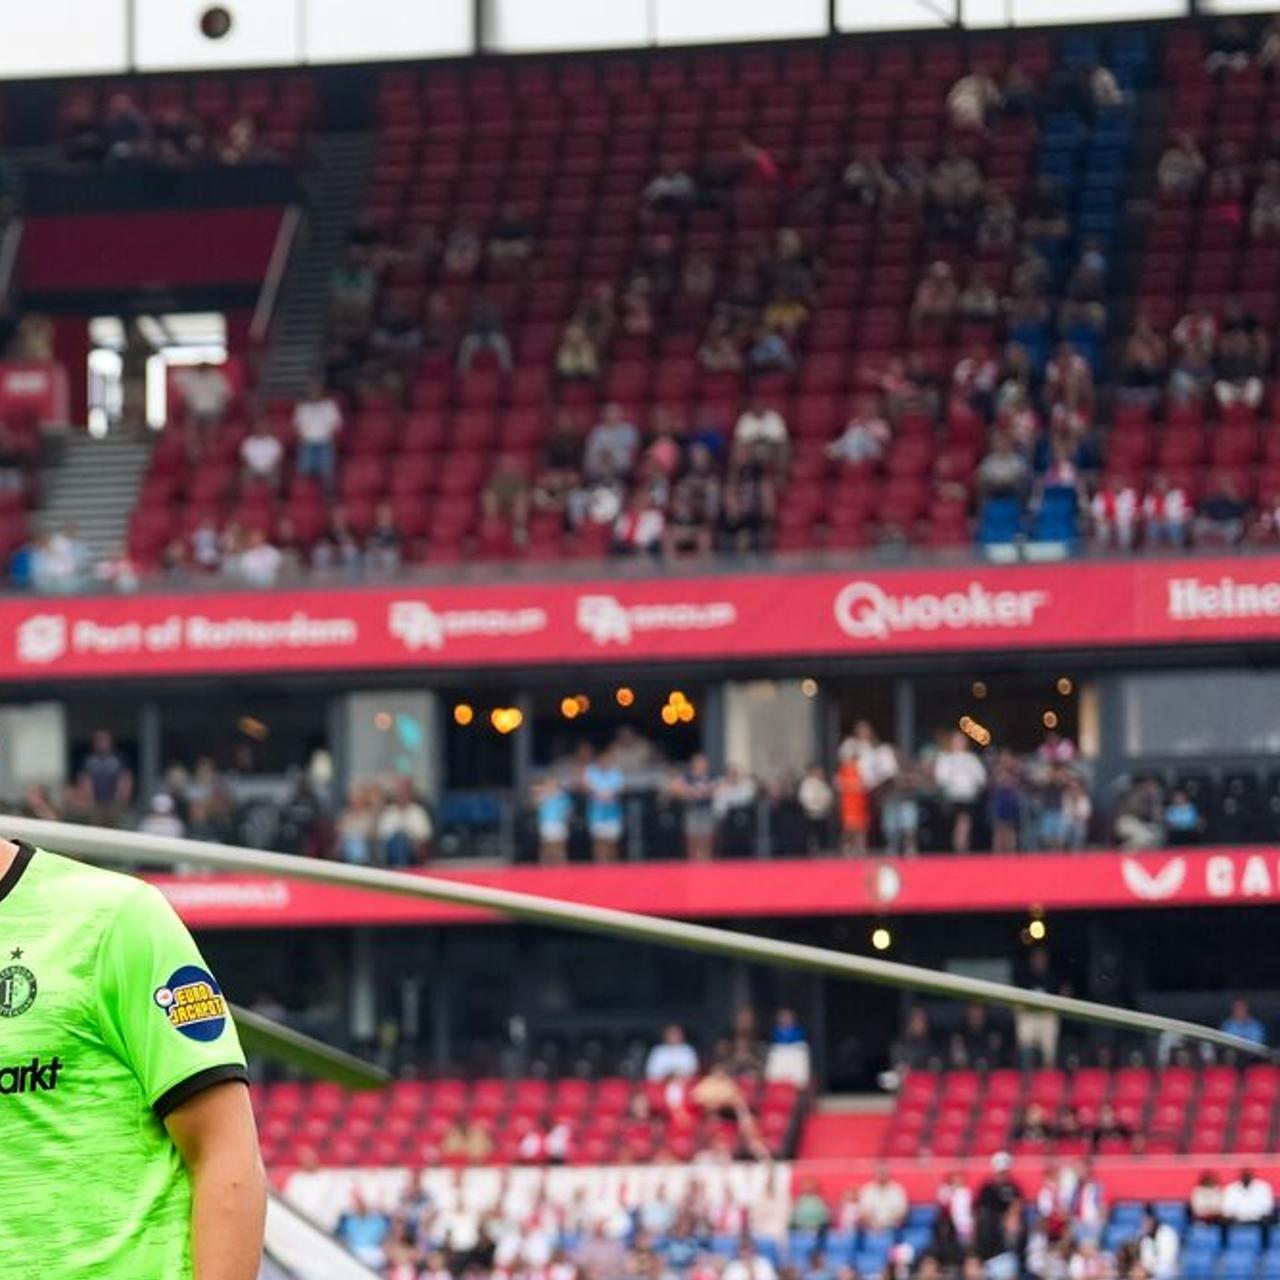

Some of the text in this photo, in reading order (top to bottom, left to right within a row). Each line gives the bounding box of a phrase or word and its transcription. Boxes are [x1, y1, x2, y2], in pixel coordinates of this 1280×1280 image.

[73, 618, 138, 655] Port
[146, 617, 183, 652] of
[185, 610, 358, 651] Rotterdam
[835, 581, 1041, 640] Quooker
